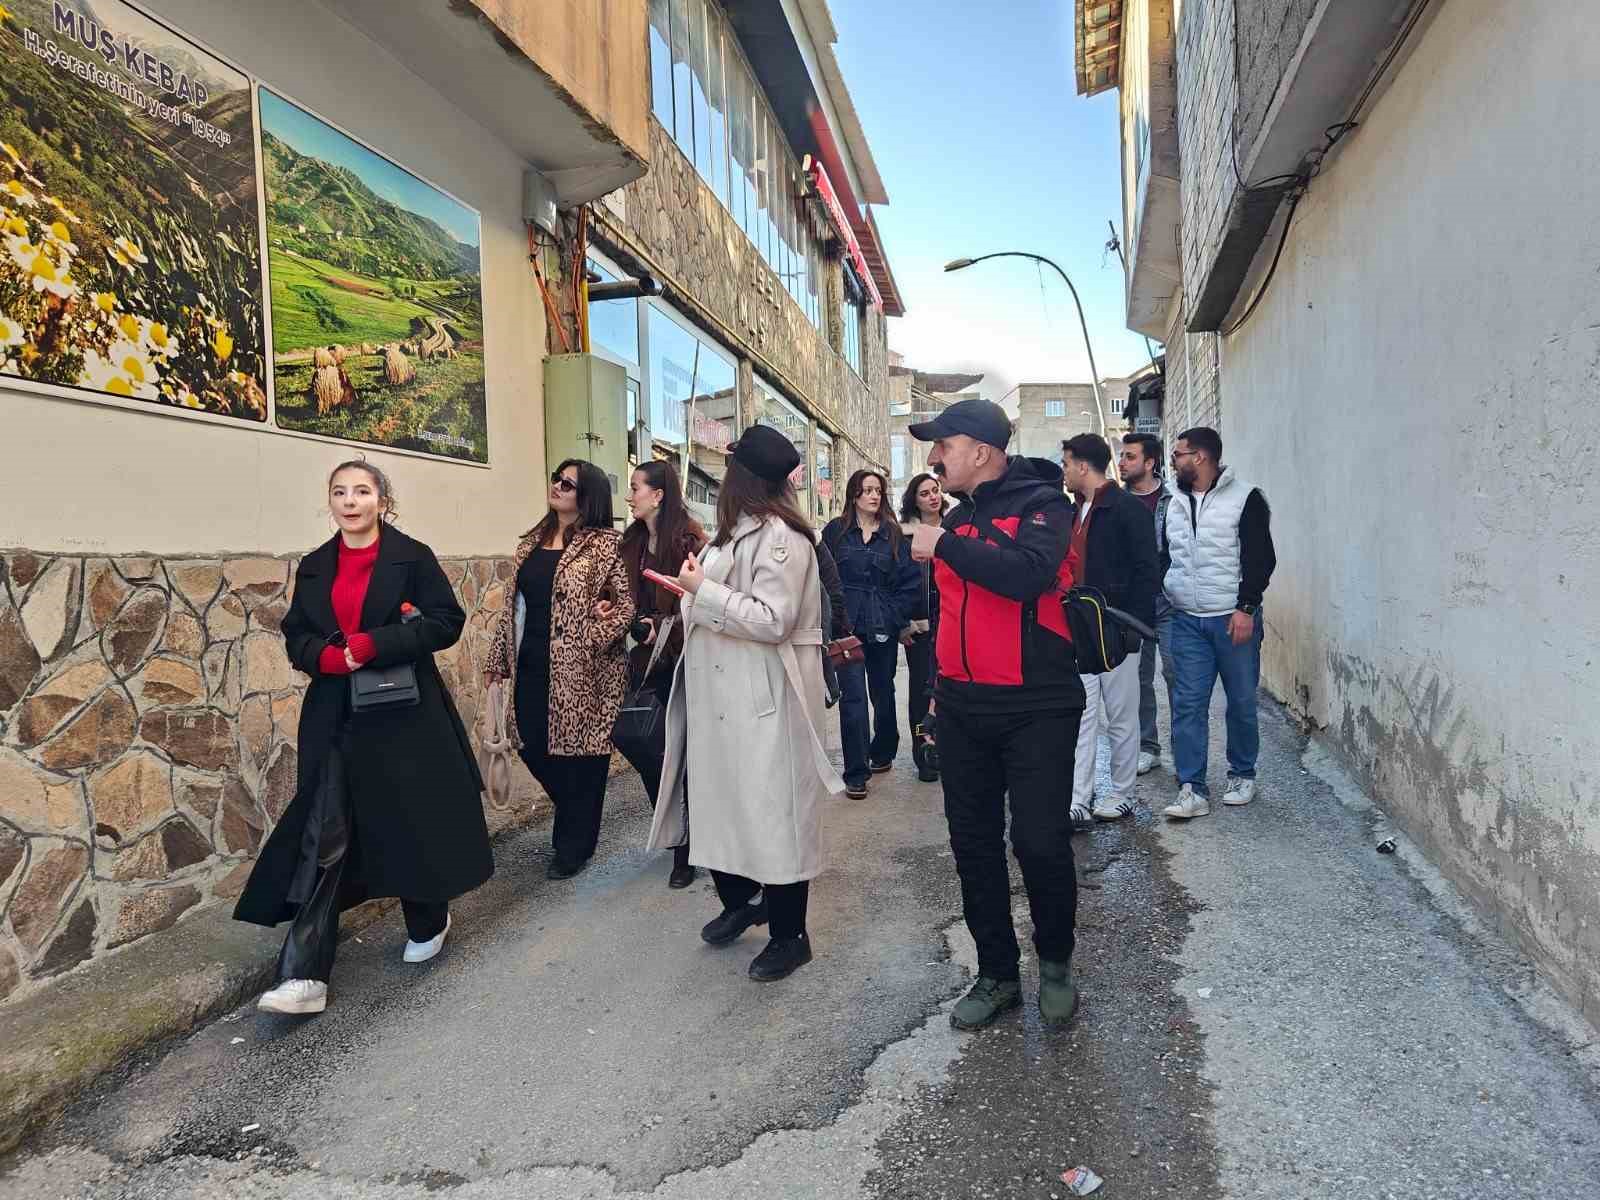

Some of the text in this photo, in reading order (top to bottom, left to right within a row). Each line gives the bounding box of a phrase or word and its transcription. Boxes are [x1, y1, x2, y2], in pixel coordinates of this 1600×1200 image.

[53, 2, 208, 108] MUŞ KEBAP
[148, 95, 180, 126] yeri
